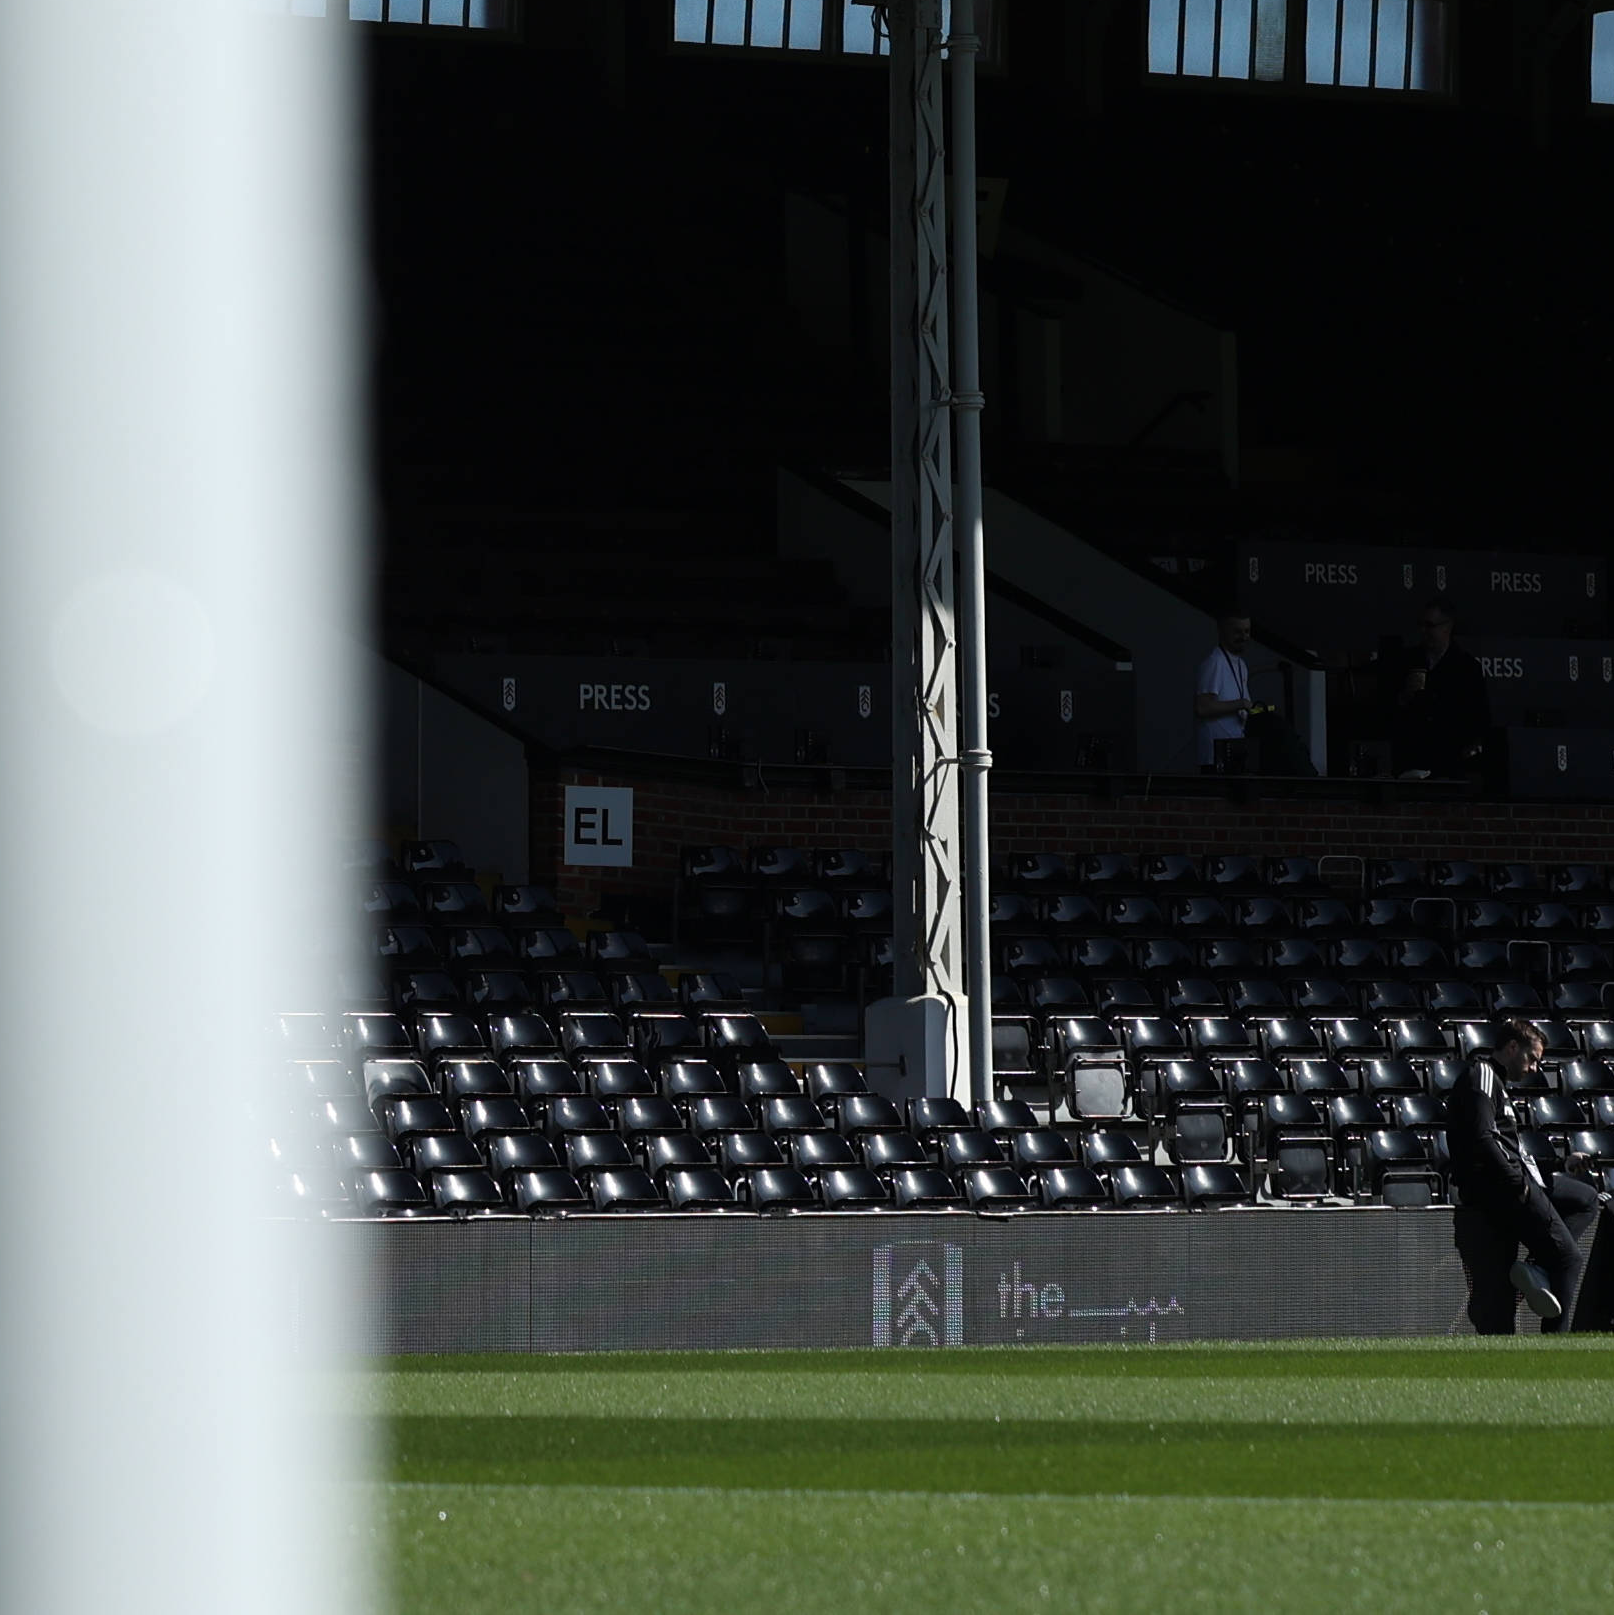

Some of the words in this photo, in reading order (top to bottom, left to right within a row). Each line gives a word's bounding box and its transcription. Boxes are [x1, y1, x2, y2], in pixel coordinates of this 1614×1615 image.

[1306, 563, 1357, 584] PRESS
[1491, 572, 1541, 592] PRESS
[1475, 657, 1523, 677] RESS
[579, 684, 651, 711] PRESS
[574, 808, 622, 846] EL
[997, 1261, 1065, 1318] the
